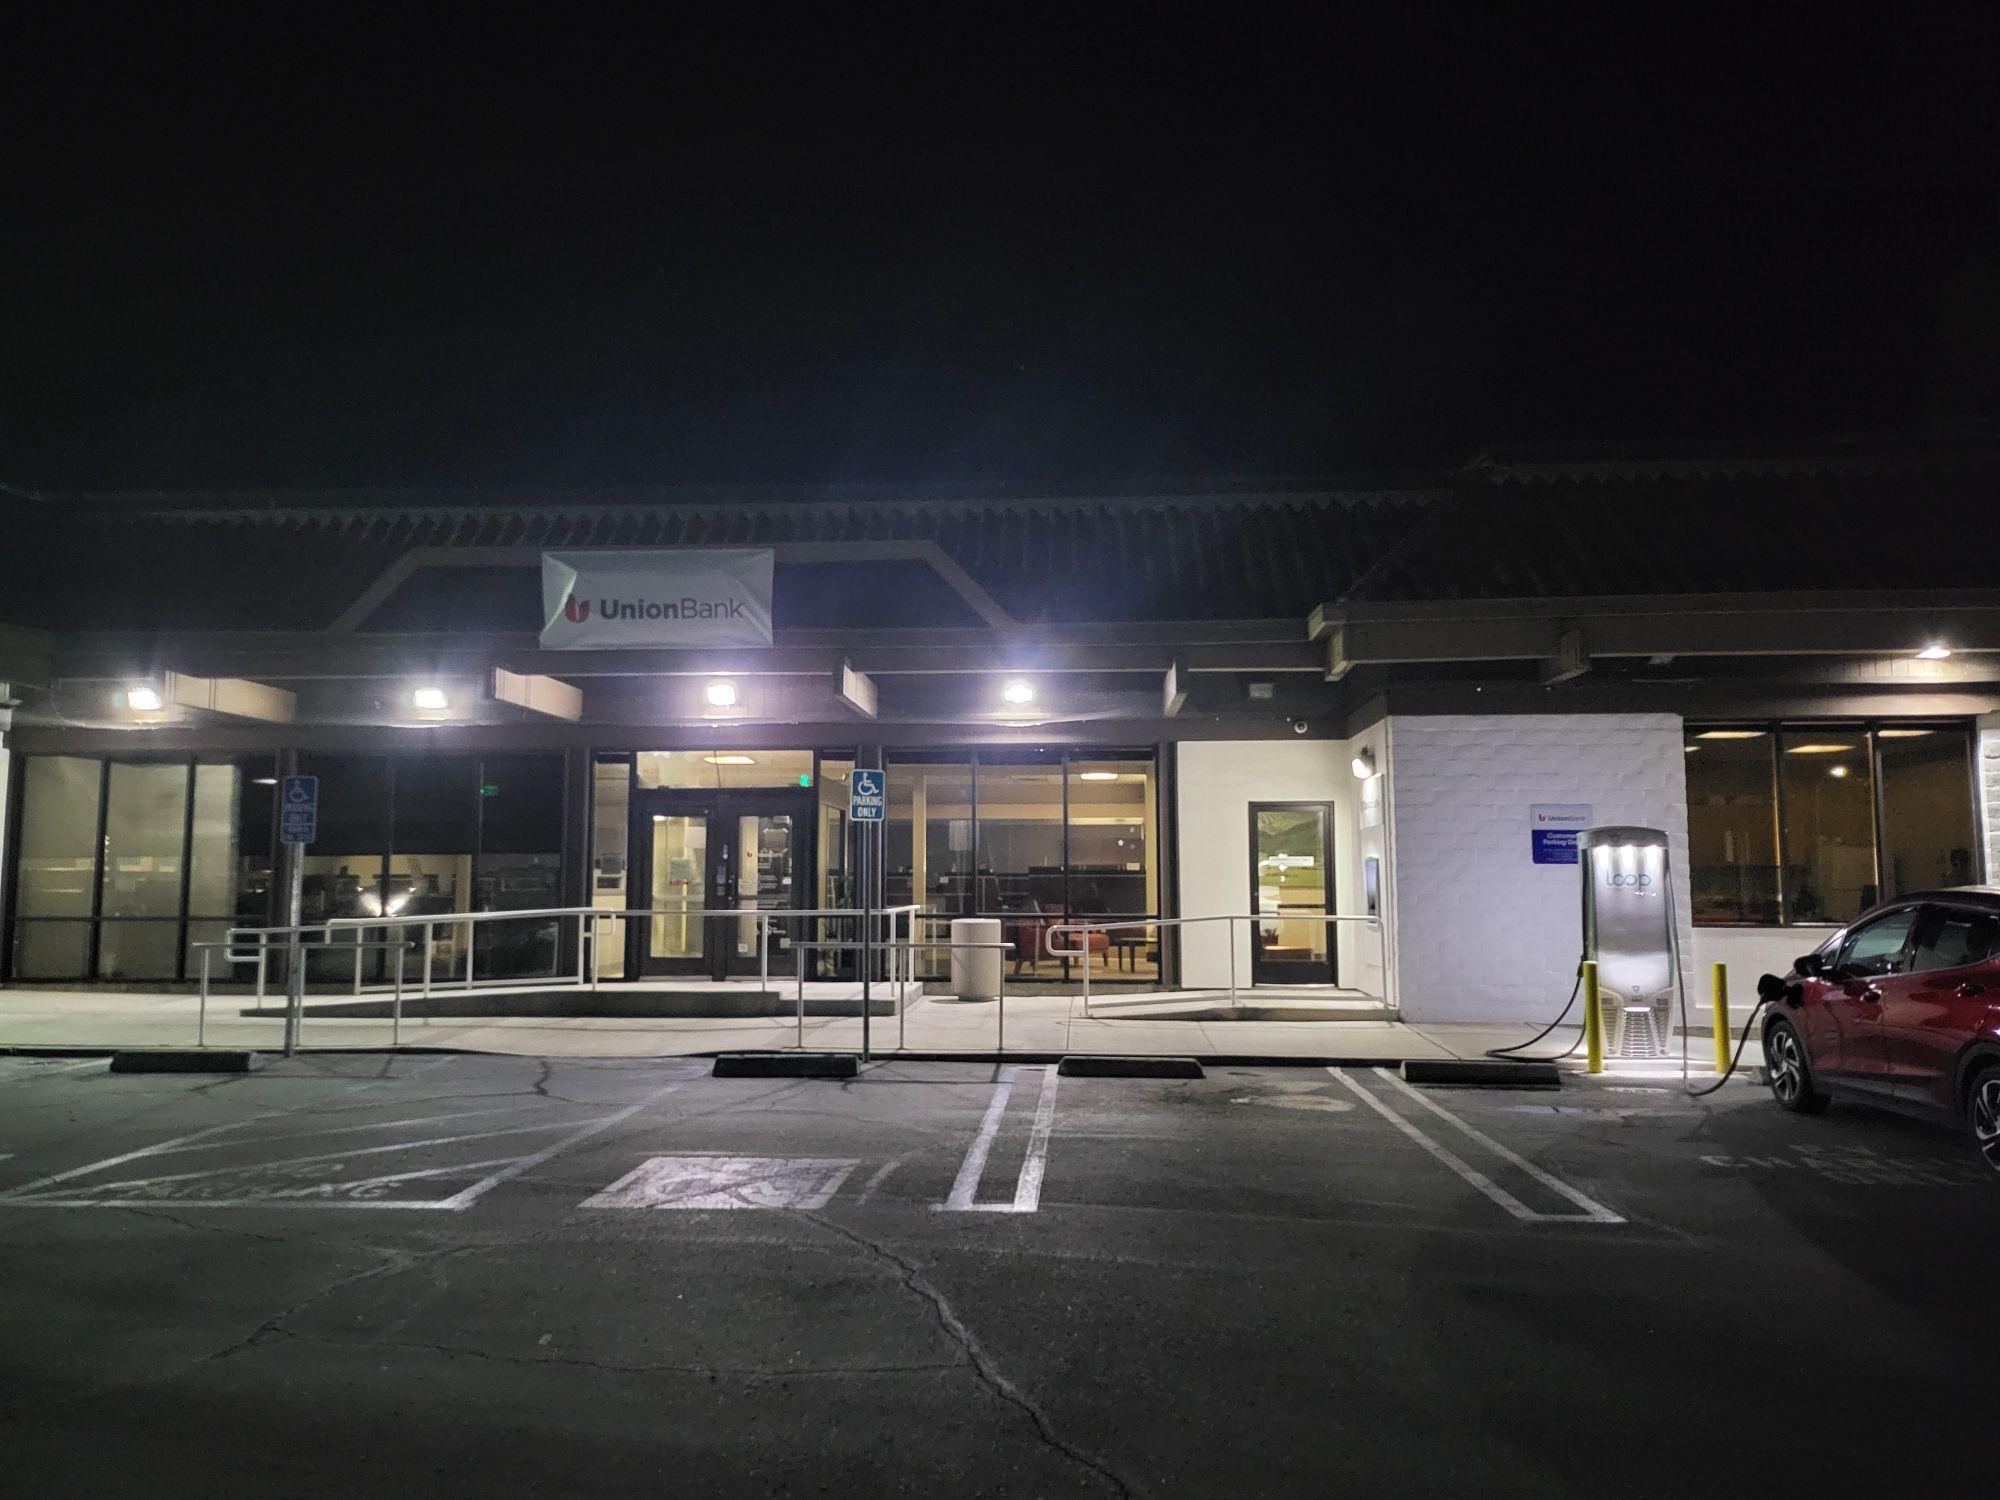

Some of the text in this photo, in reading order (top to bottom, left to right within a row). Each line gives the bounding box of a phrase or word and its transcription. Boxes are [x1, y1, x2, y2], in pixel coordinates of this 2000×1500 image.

[600, 597, 744, 621] UnionBank
[853, 795, 883, 806] PARKING
[857, 806, 877, 818] ONLY
[1606, 870, 1652, 891] loop
